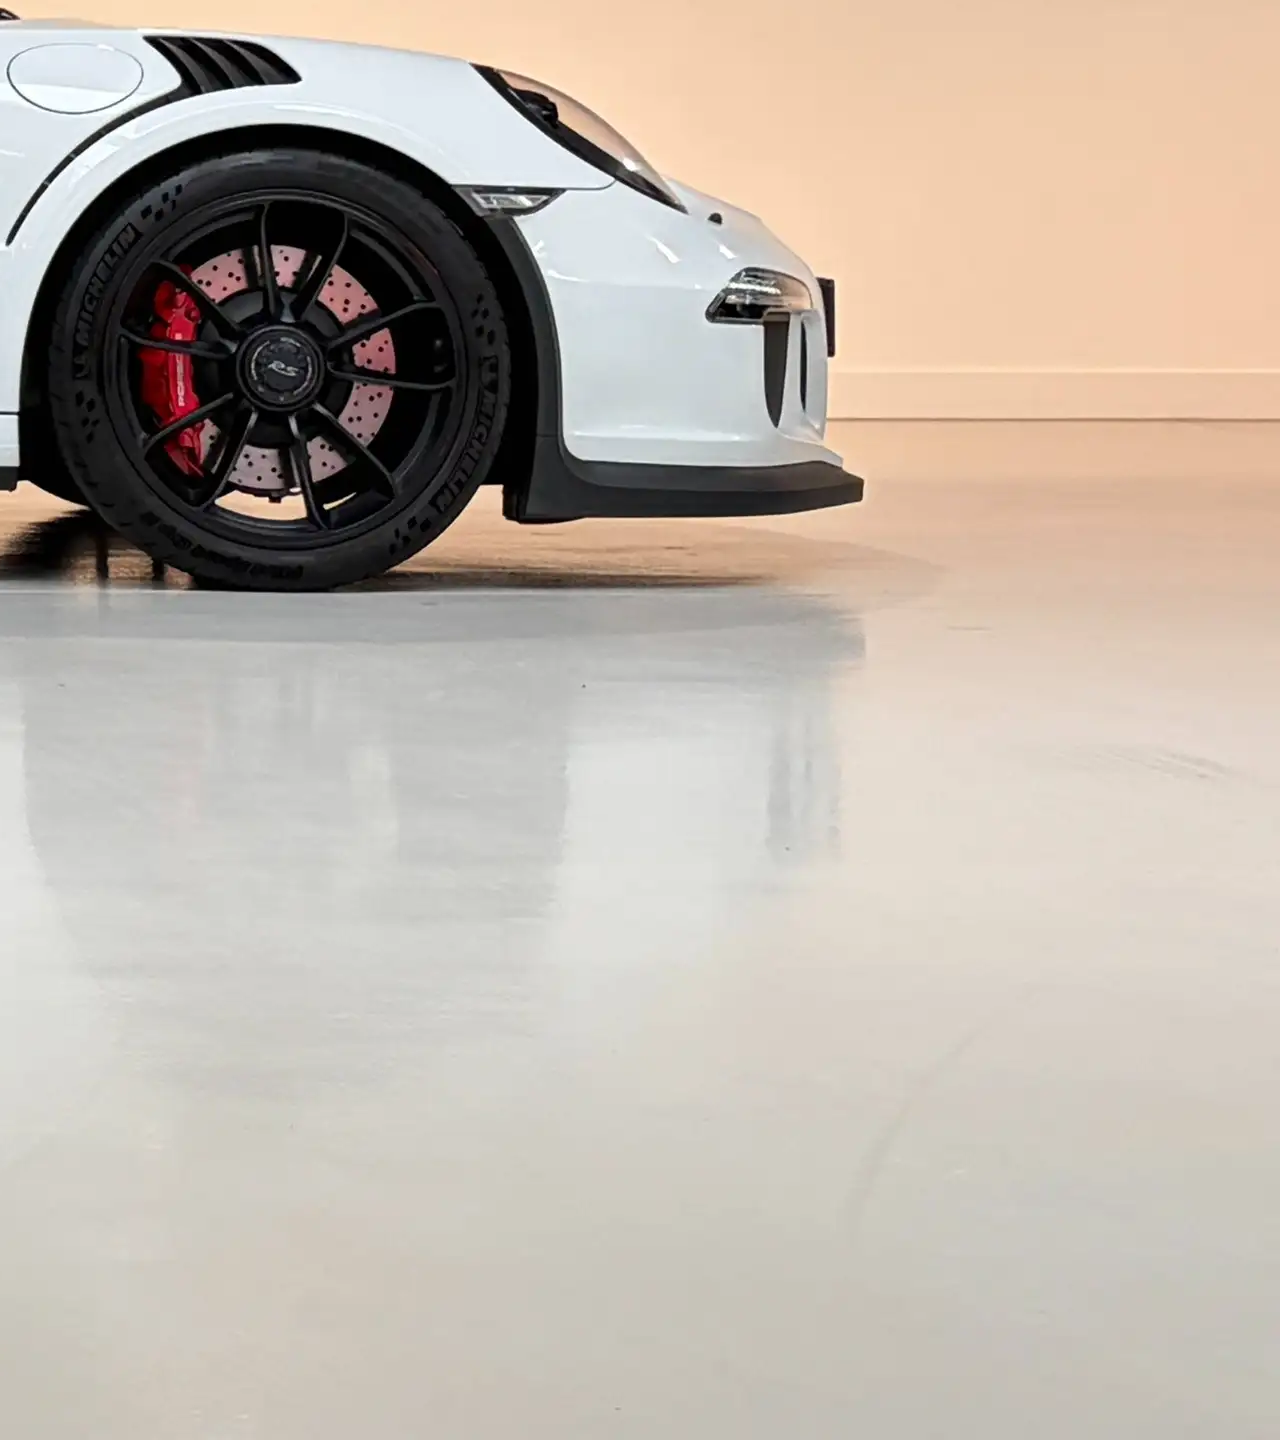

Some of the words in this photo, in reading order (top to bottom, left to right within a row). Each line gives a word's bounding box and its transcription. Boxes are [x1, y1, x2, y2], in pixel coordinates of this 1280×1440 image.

[74, 223, 141, 347] MICHELIN
[268, 360, 299, 376] RS
[430, 390, 497, 513] MICHELIN
